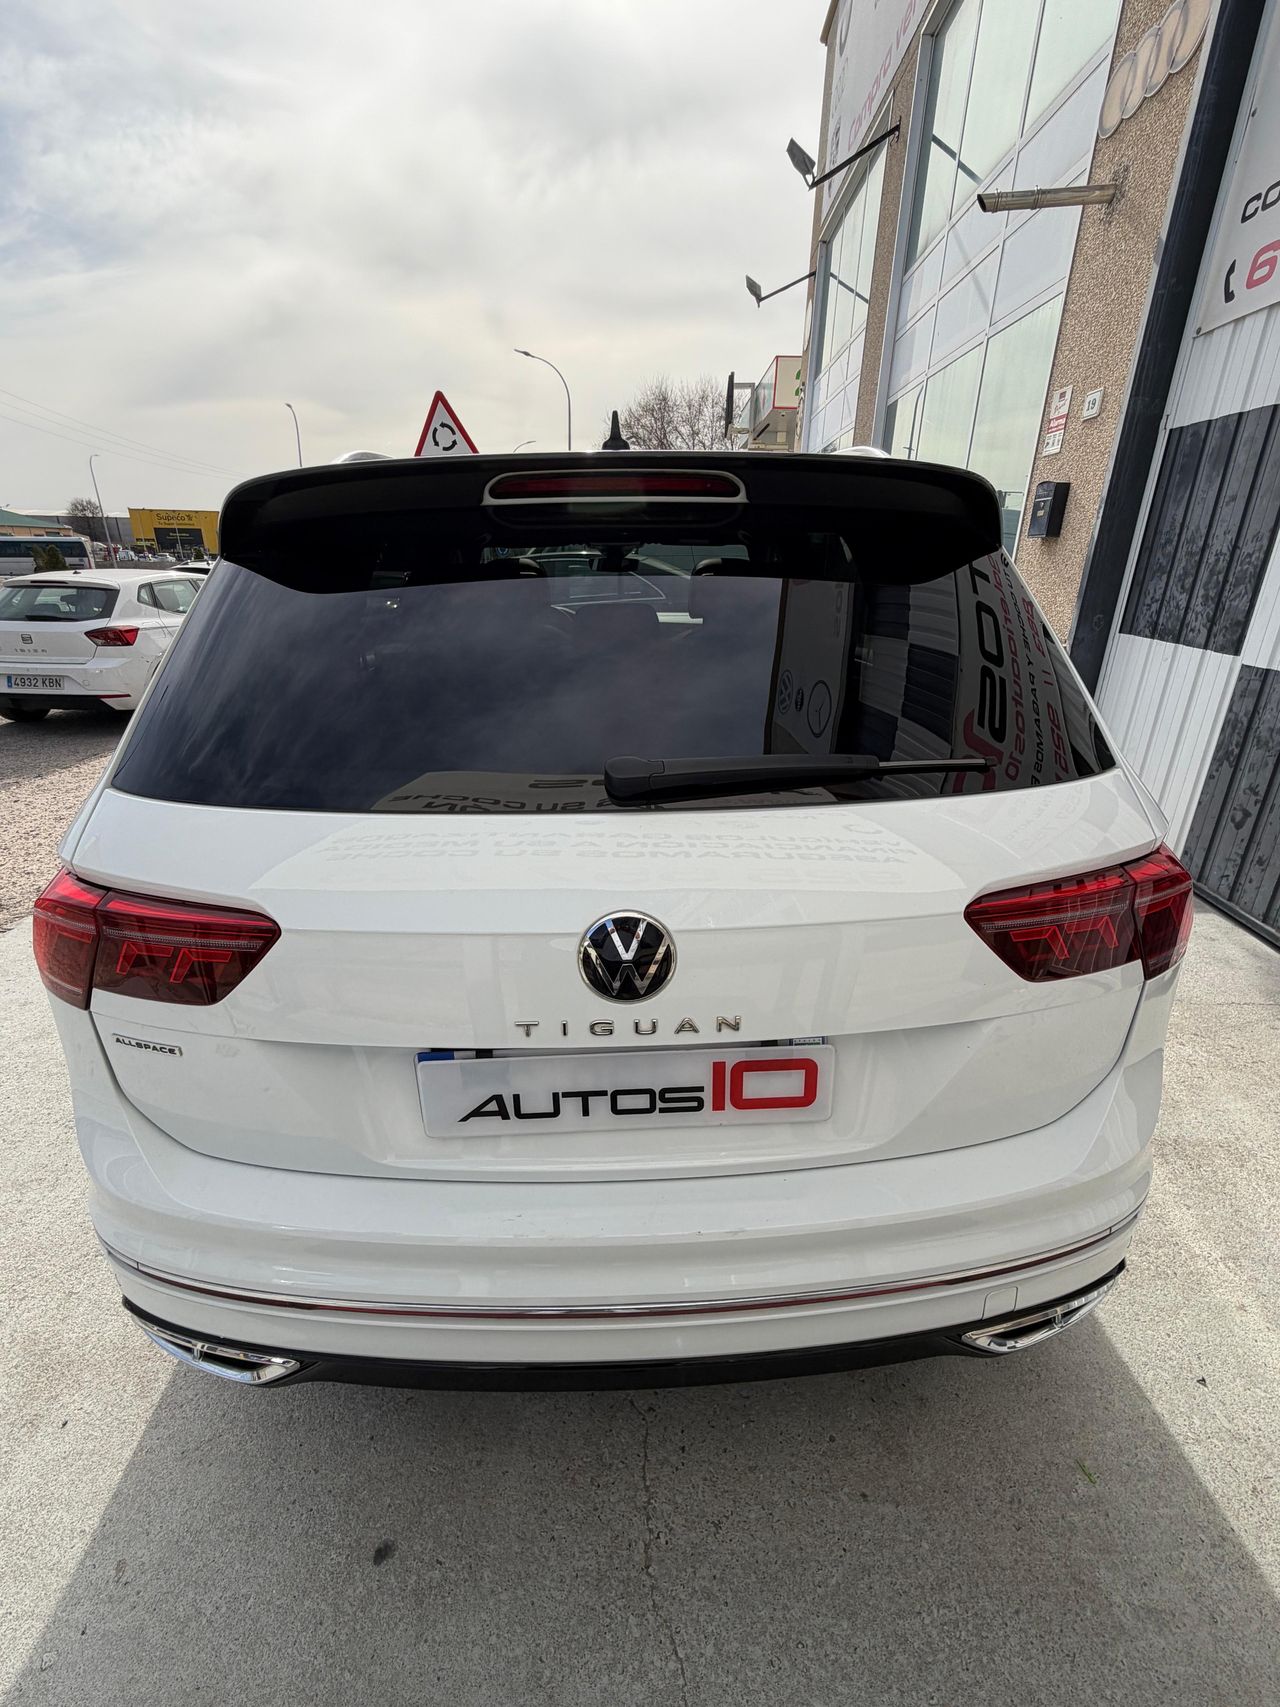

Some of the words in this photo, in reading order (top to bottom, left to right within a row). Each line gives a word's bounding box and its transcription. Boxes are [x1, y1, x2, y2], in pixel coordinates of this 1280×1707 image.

[1086, 397, 1097, 411] 19
[14, 677, 38, 687] 4932
[42, 677, 61, 688] KBN
[514, 1014, 743, 1038] TIGUAN
[115, 1037, 177, 1055] ALLSPACE
